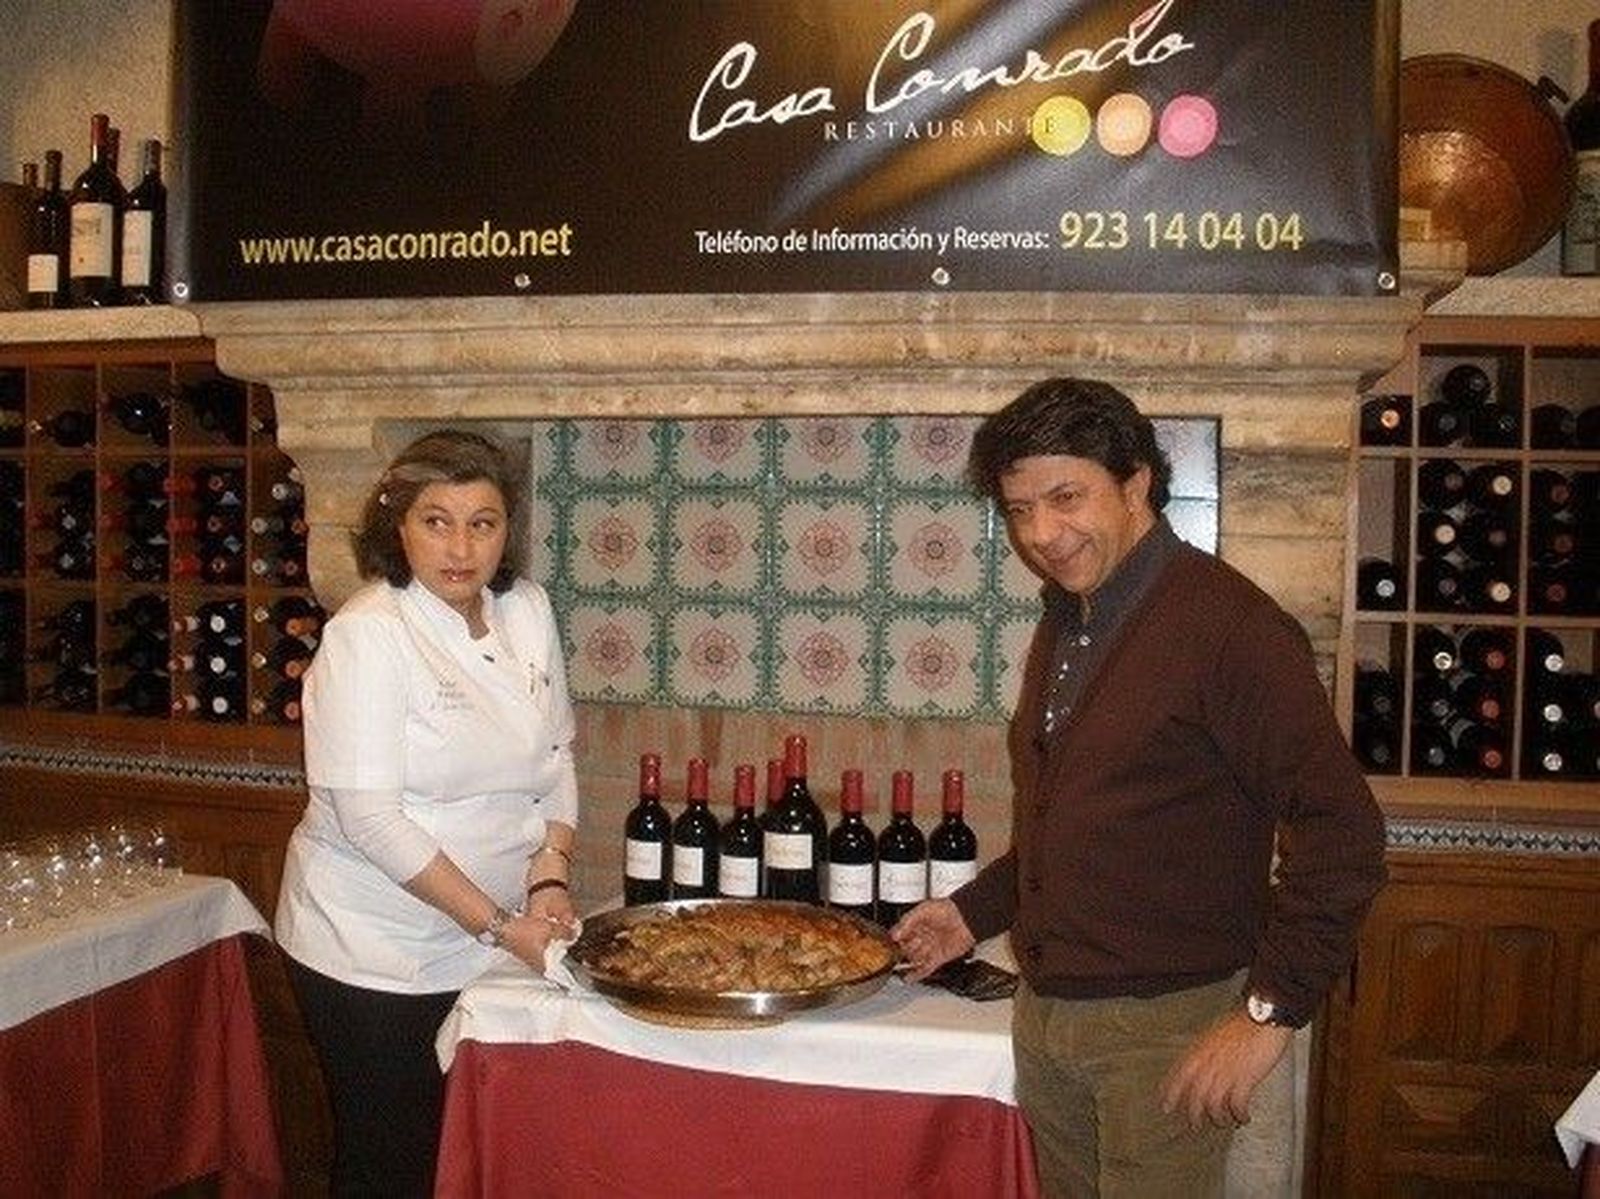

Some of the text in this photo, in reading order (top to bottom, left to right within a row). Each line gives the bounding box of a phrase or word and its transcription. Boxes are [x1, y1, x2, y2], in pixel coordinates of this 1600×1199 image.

[688, 0, 1195, 143] Casa Conrado
[239, 220, 573, 264] www.casaconrado.net
[694, 210, 1304, 255] Teléfono de Información y Reservas: 923 14 04 04
